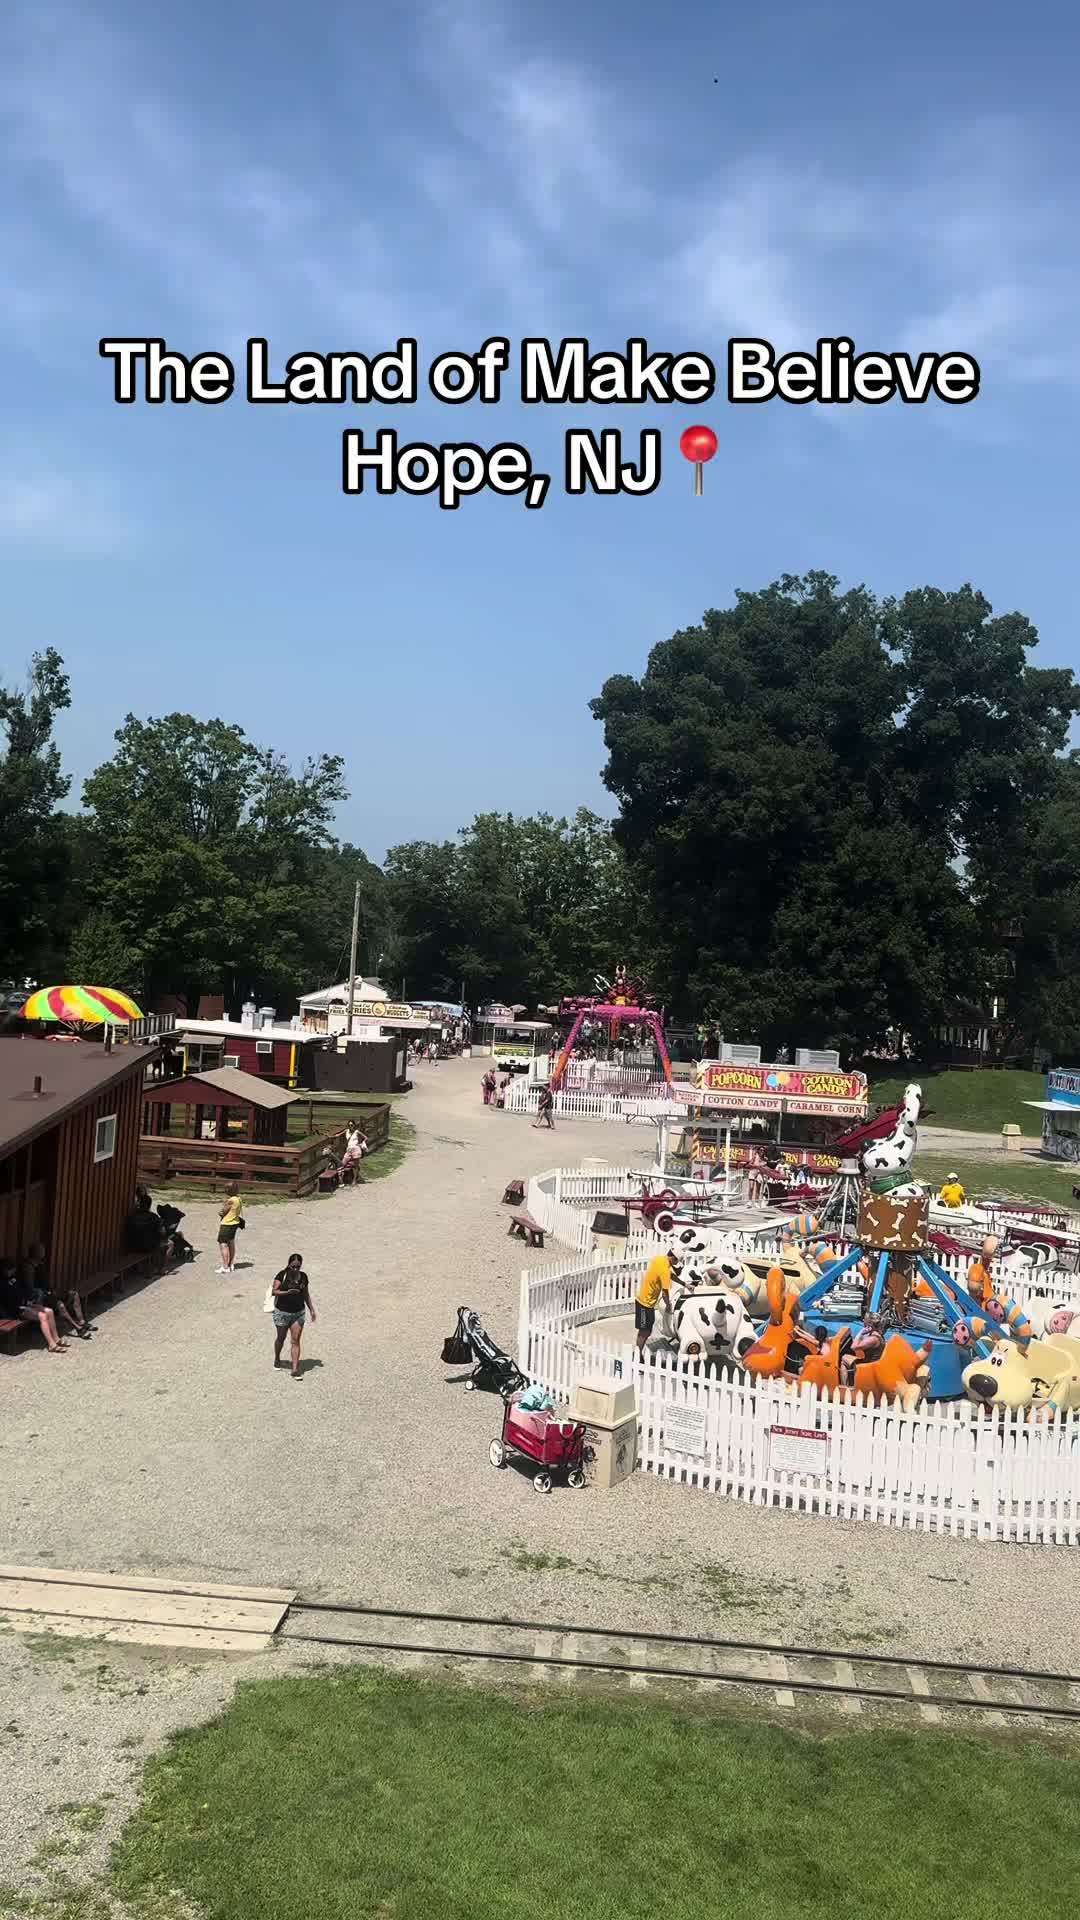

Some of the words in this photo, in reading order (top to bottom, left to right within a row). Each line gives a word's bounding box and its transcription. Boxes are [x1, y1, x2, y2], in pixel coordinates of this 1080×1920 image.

[711, 1071, 763, 1089] POPCORN
[801, 1075, 853, 1088] COTTON
[806, 1084, 849, 1096] CANDY
[707, 1096, 745, 1106] COTTON
[747, 1099, 779, 1108] CANDY
[790, 1102, 834, 1113] CARAMEL
[837, 1105, 862, 1114] CORN
